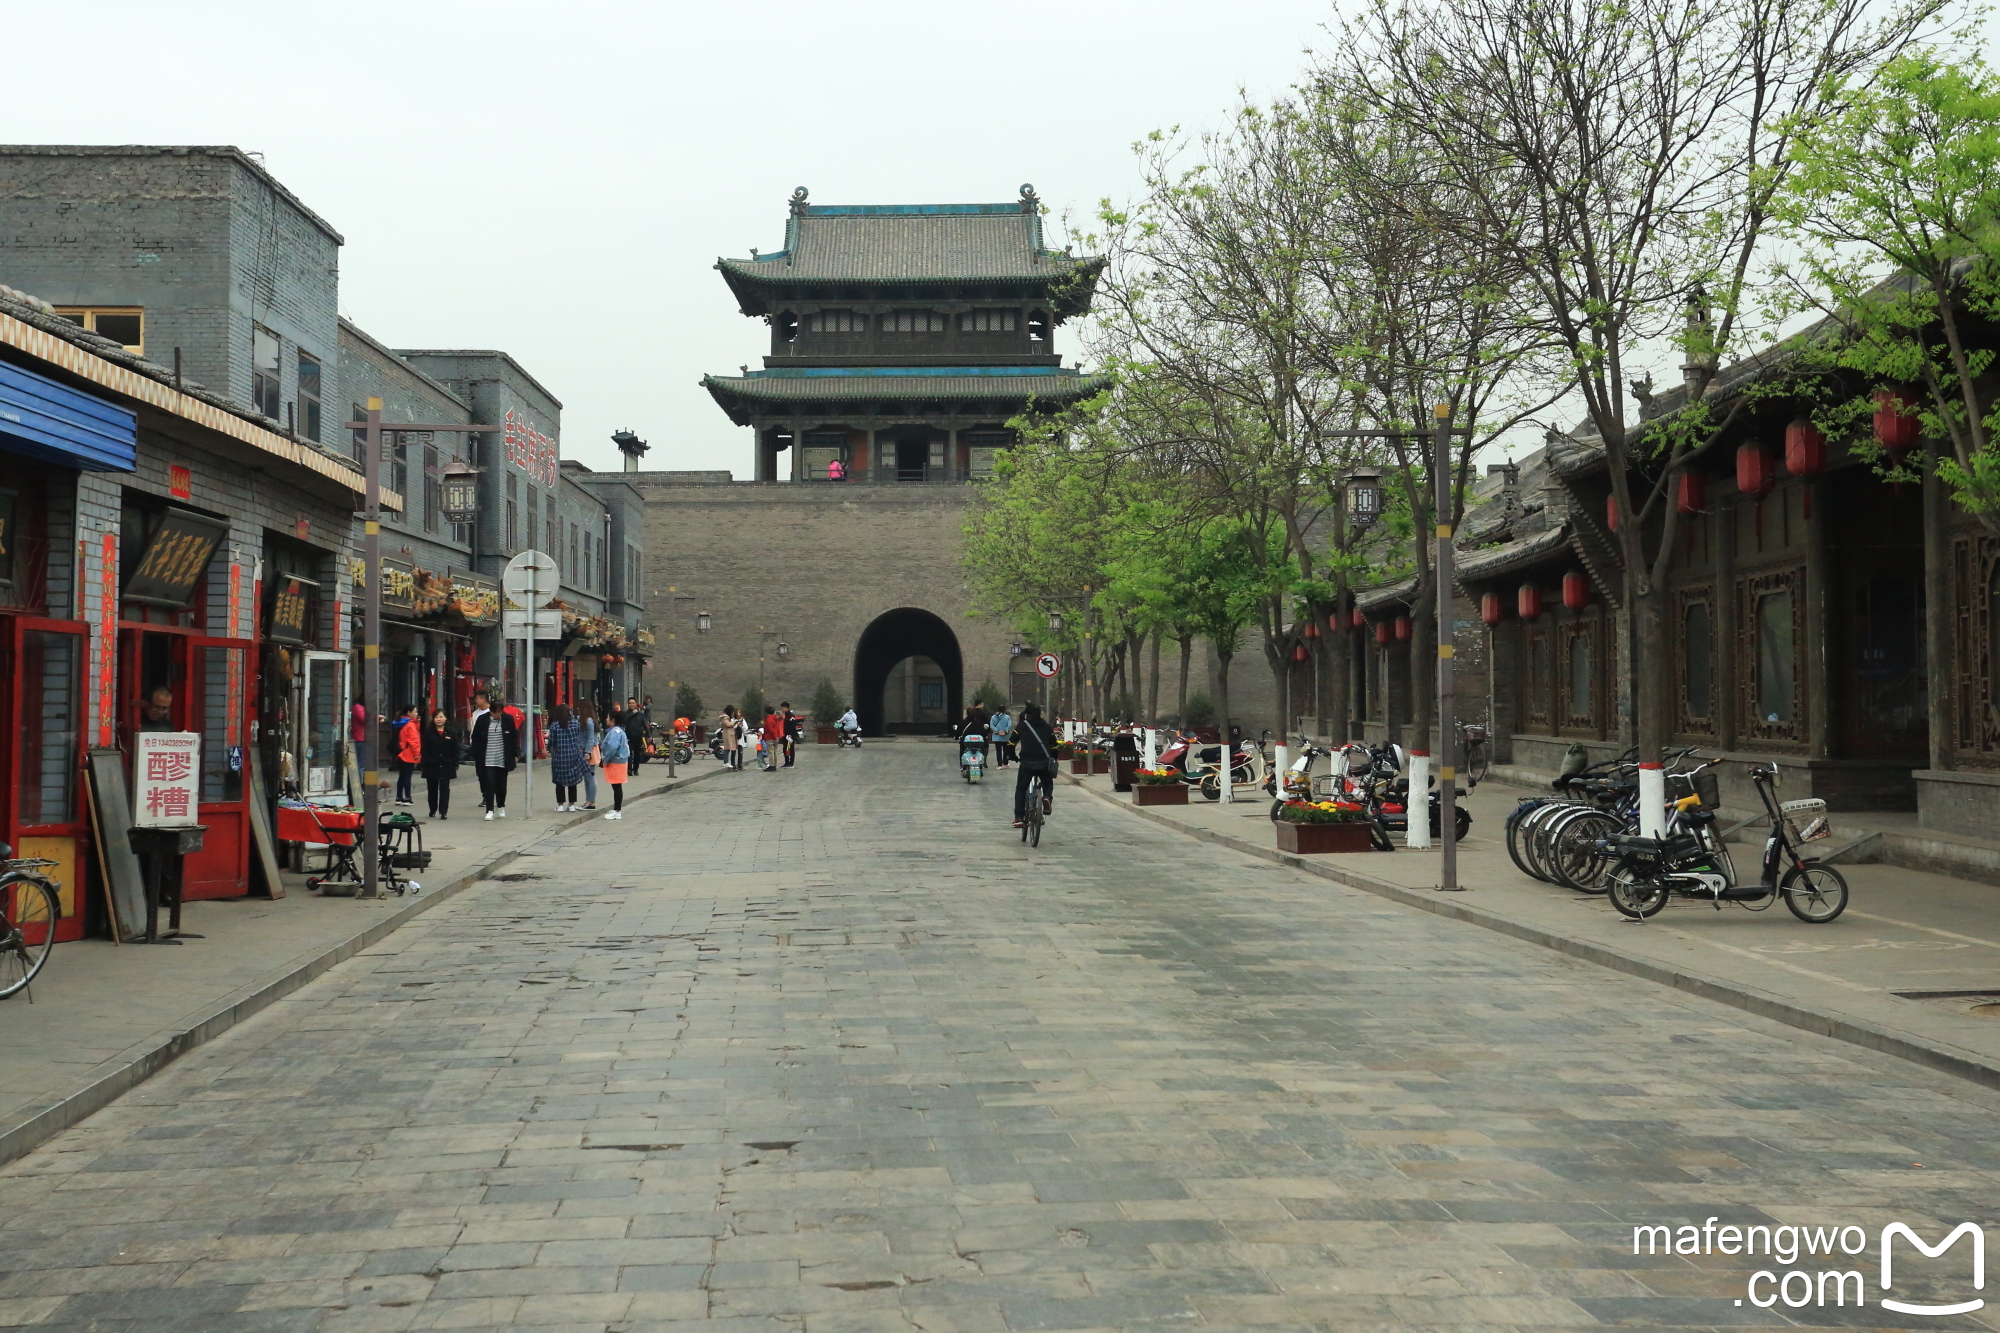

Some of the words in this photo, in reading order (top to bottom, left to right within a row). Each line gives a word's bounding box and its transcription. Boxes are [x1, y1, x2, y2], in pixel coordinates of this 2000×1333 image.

[505, 406, 556, 488] 毛主席万岁
[146, 752, 191, 818] 醪糟
